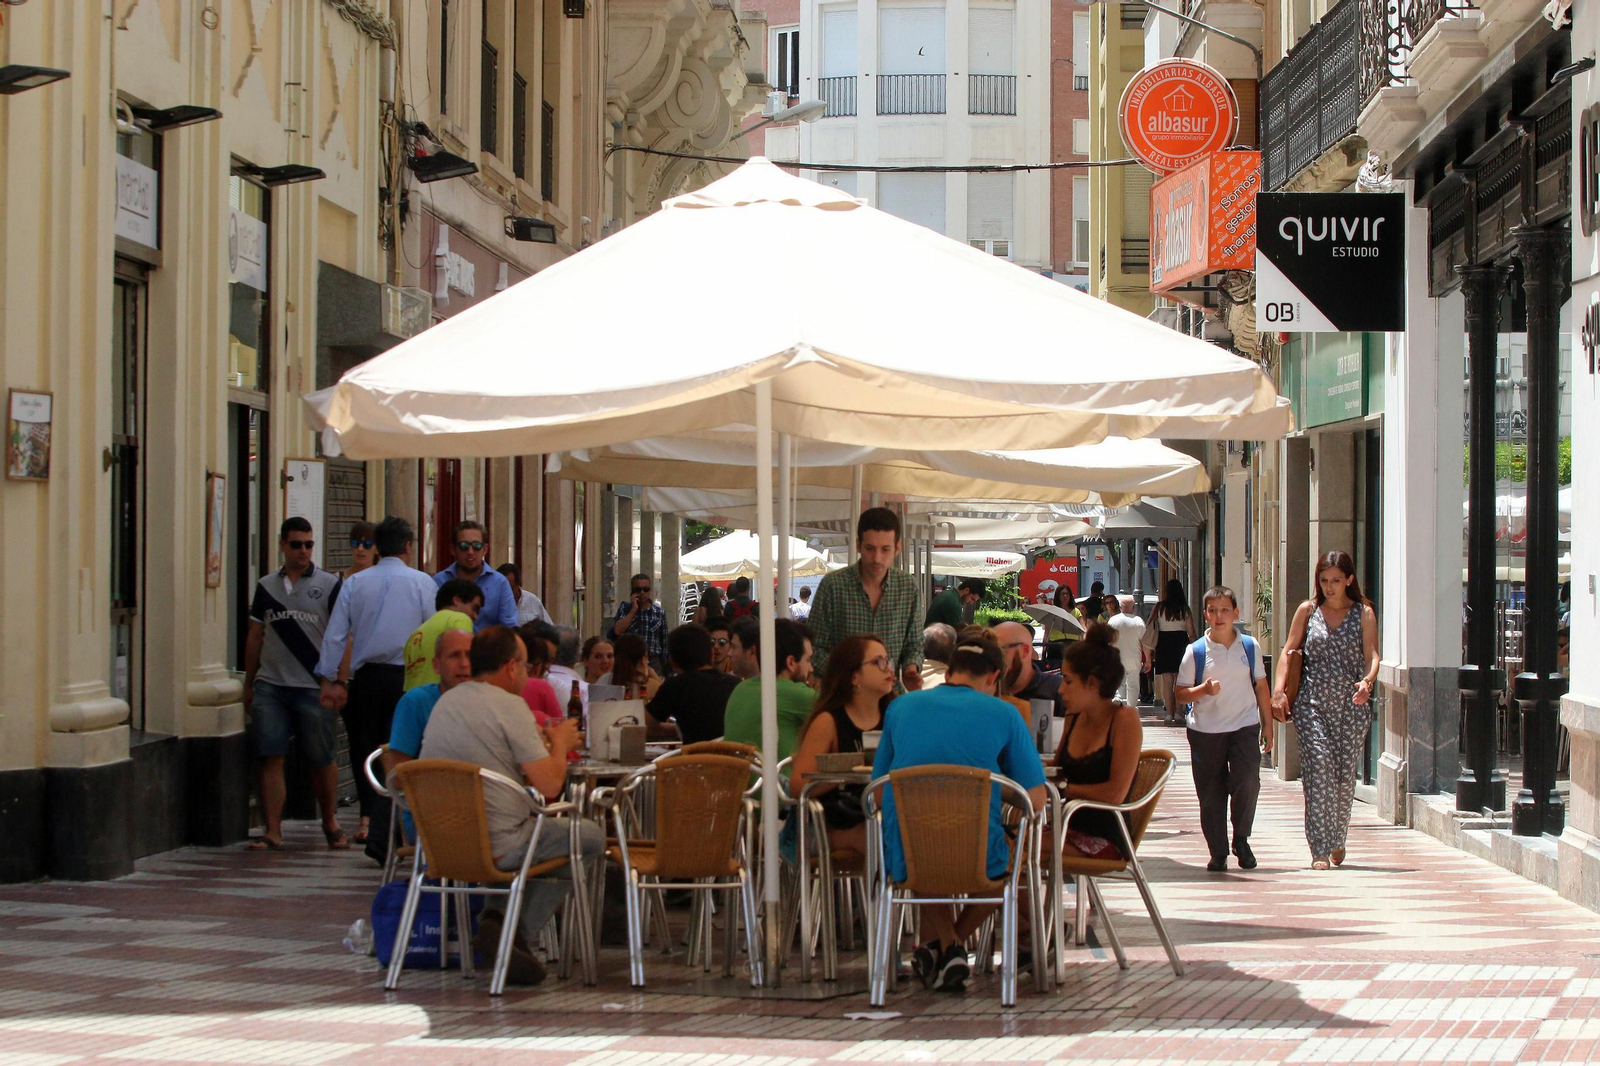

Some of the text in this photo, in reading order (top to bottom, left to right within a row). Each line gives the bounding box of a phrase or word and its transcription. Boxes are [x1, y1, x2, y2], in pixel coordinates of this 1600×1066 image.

[1130, 67, 1228, 110] INMOBILIARIAS ALBASUR
[1148, 111, 1209, 132] albasur
[1149, 151, 1171, 167] REAL
[1332, 246, 1379, 257] ESTUDIO
